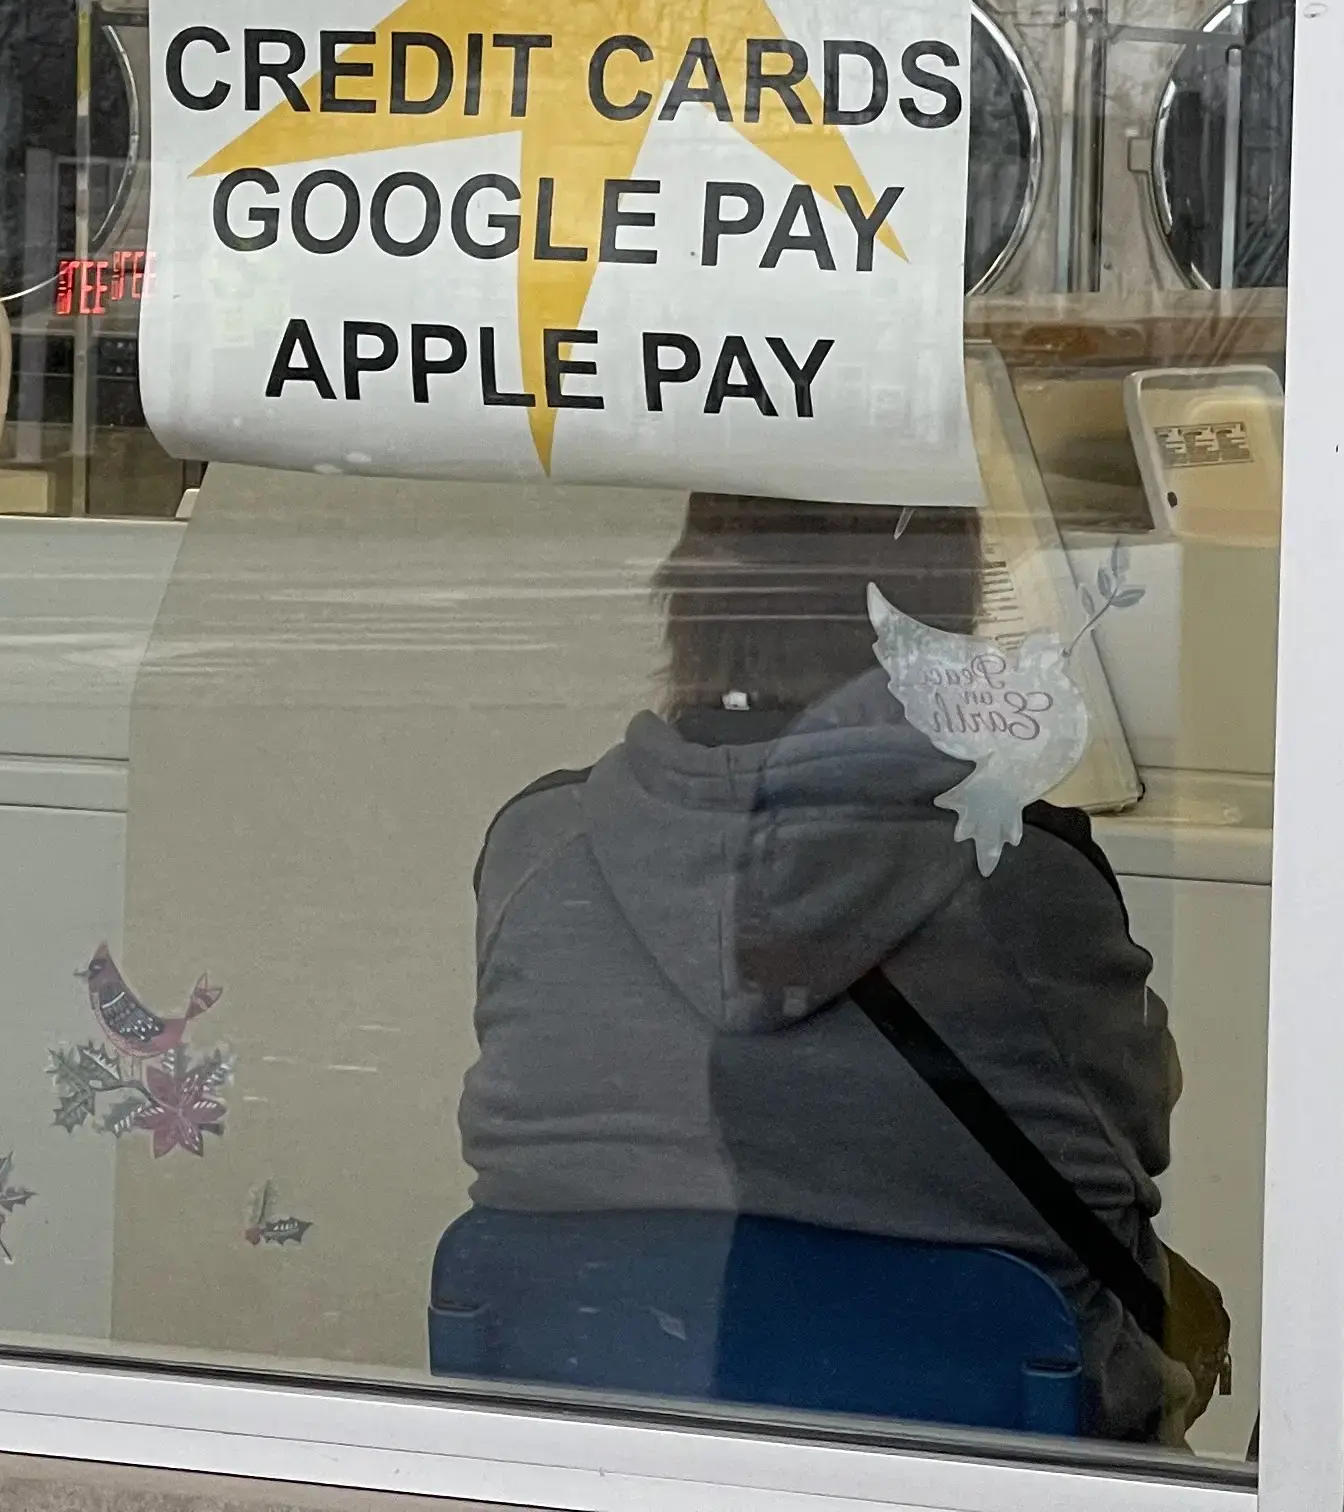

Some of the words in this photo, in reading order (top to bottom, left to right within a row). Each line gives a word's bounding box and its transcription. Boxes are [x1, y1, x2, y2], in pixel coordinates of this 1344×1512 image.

[164, 25, 552, 118] CREDIT
[587, 35, 963, 129] CARDS
[211, 166, 661, 266] GOOGLE
[701, 181, 905, 273] PAY
[264, 318, 605, 410] APPLE
[641, 331, 836, 419] PAY
